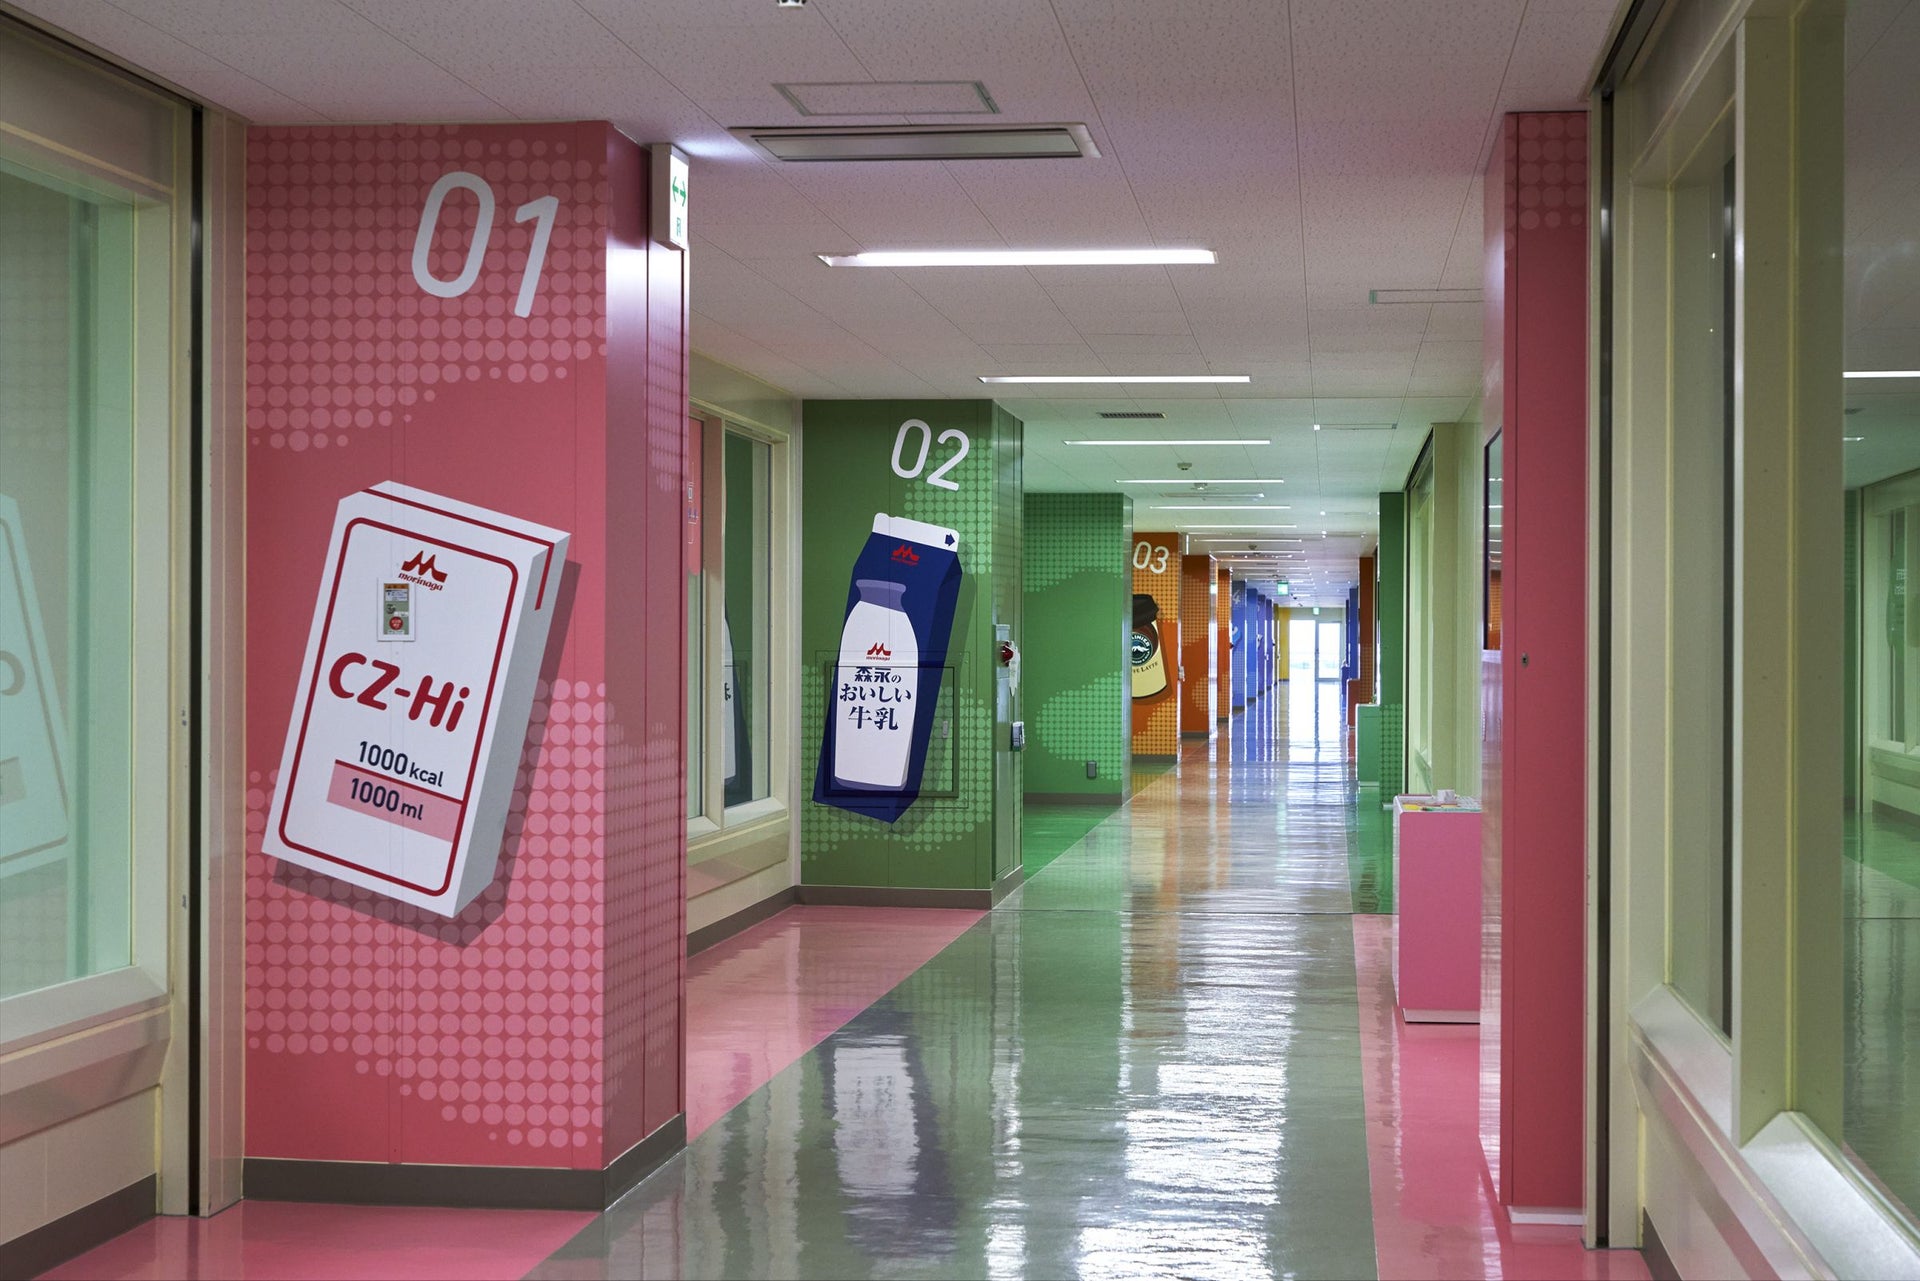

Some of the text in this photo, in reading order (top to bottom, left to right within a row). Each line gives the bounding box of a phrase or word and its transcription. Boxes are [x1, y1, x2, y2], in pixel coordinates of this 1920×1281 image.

[411, 171, 559, 318] 01
[891, 418, 970, 491] 02
[1132, 541, 1169, 574] 03
[398, 572, 443, 591] morinaga
[328, 652, 470, 732] CZ-Hi
[839, 683, 912, 703] おいしい
[854, 666, 902, 683] 森永の
[847, 705, 899, 730] 牛乳
[359, 741, 443, 787] 1000 kcal
[351, 778, 424, 820] 1000 ml
